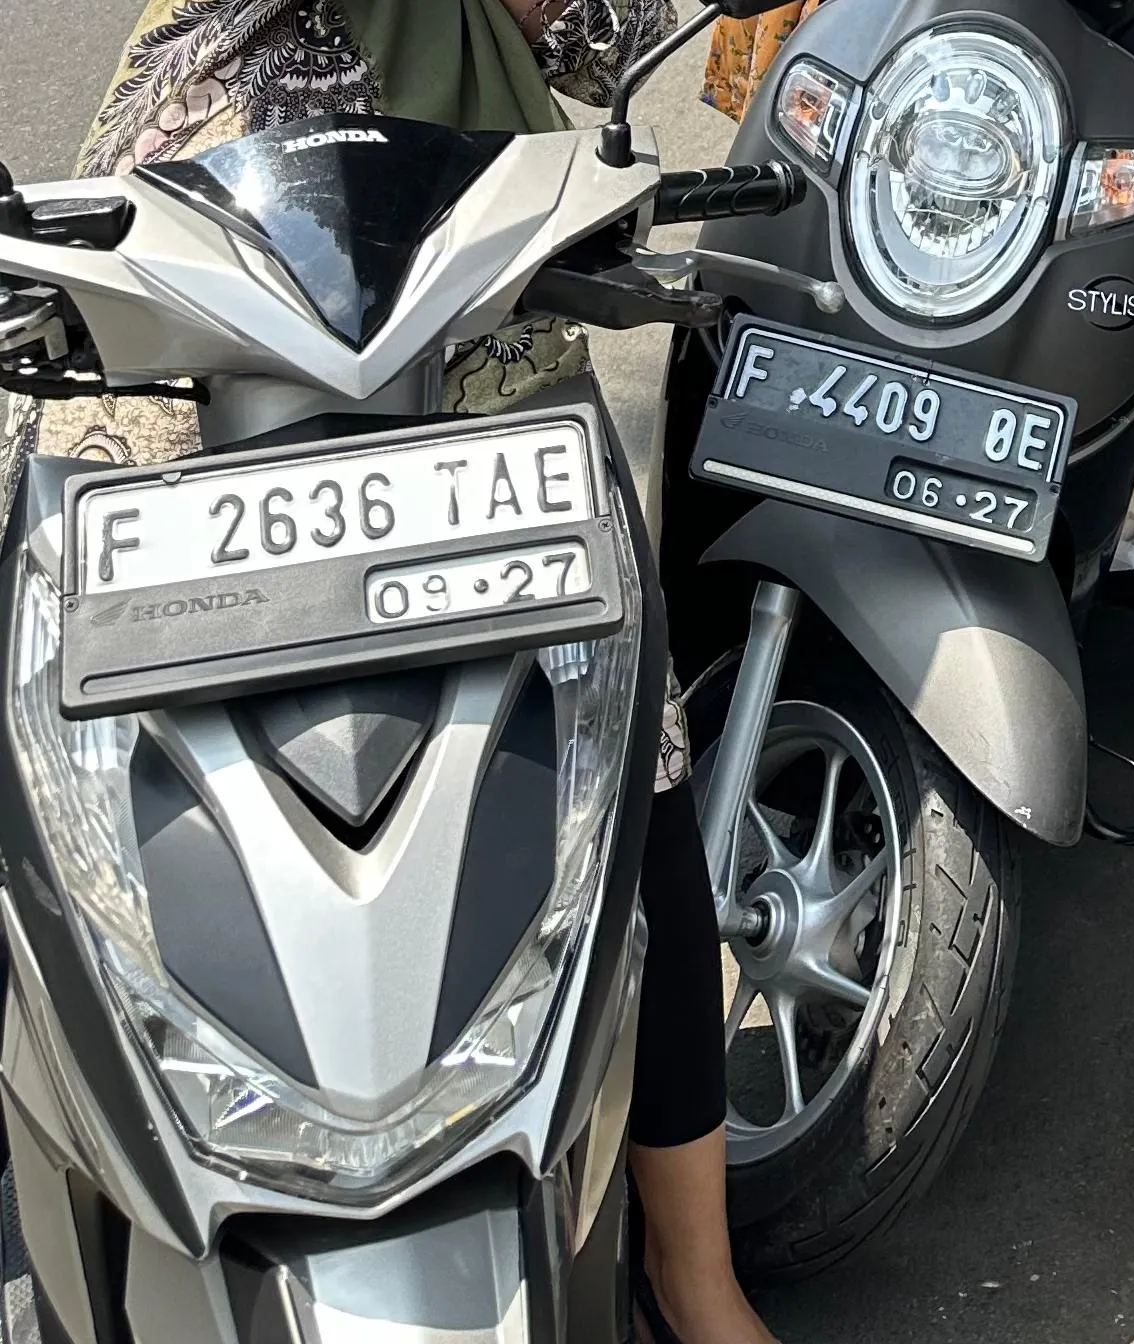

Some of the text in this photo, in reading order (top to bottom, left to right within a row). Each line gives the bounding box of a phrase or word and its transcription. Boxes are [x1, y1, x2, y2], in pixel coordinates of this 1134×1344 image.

[281, 129, 390, 154] HONDA
[736, 344, 775, 398] F
[99, 444, 574, 583] F 2636 TAE
[132, 588, 271, 624] HONDA
